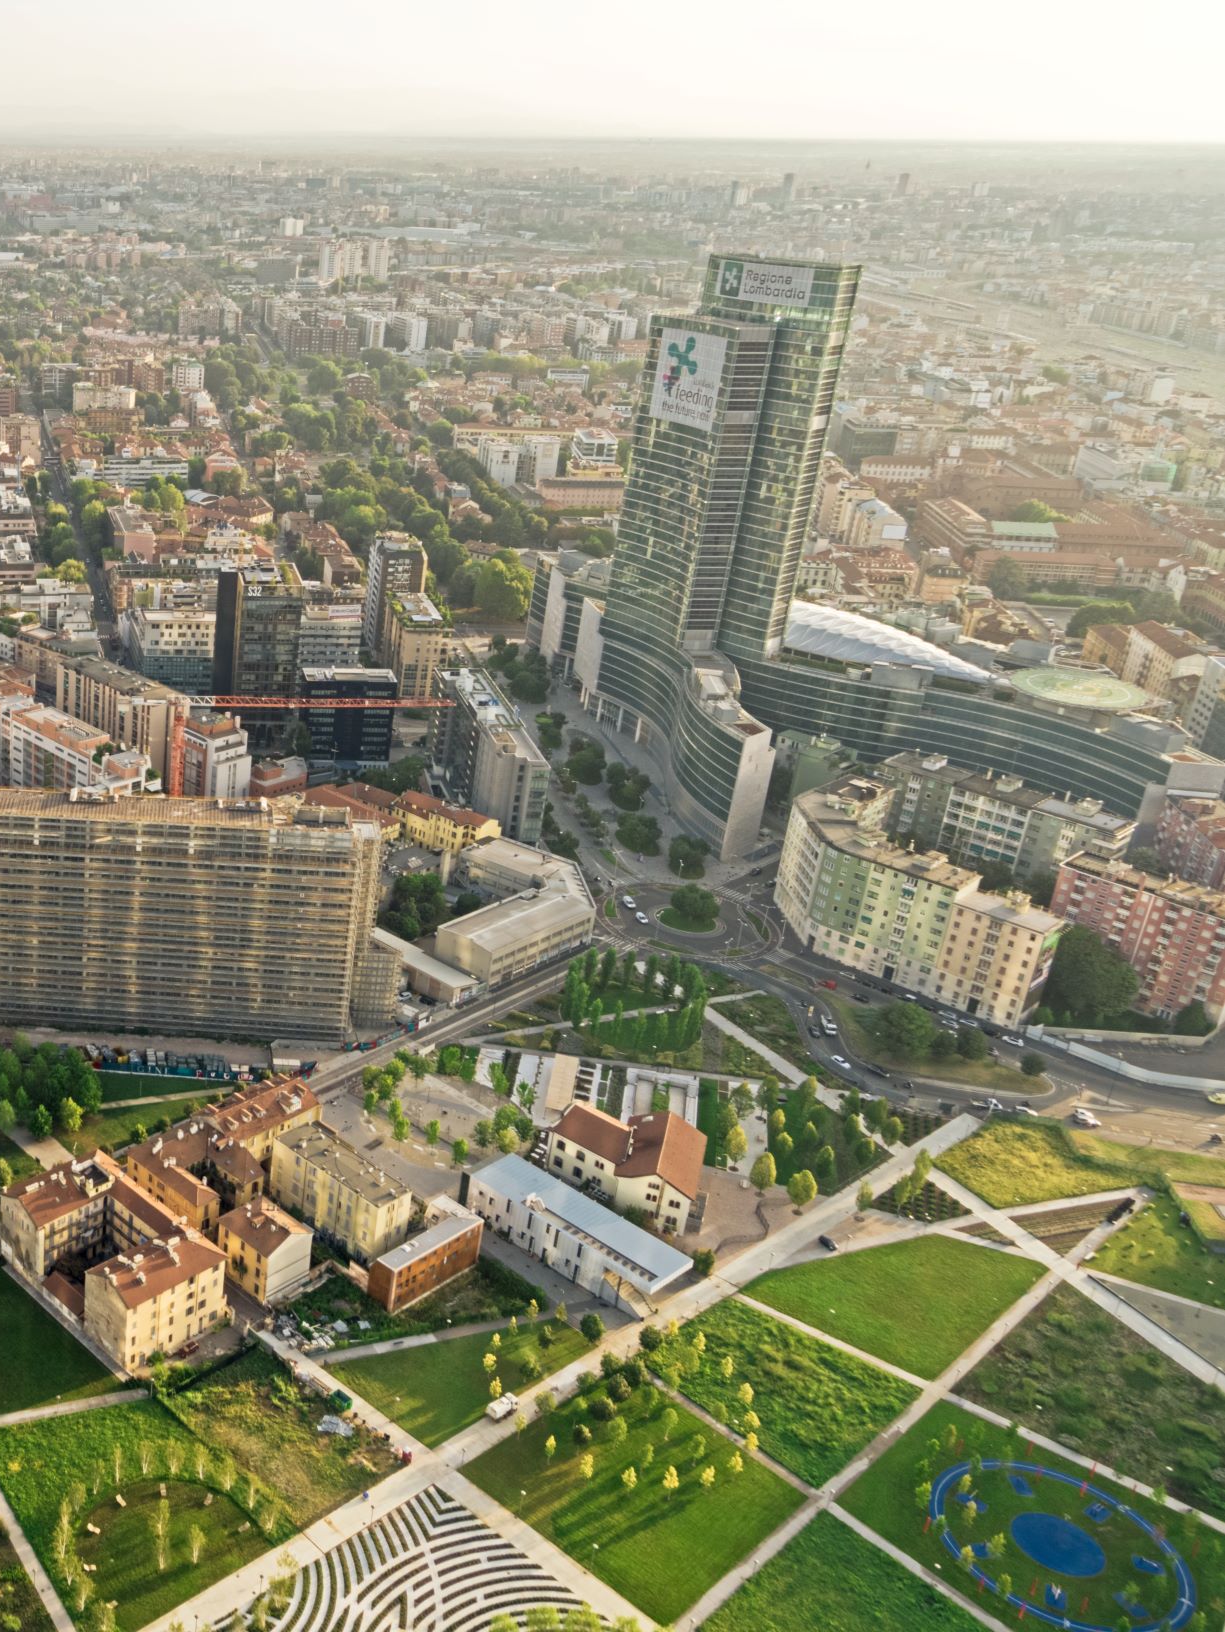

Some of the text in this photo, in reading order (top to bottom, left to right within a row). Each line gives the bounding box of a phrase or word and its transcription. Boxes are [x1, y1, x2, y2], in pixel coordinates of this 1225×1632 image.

[745, 269, 793, 285] Regione
[743, 282, 806, 300] Lombardia
[662, 400, 674, 413] the
[675, 384, 714, 413] feeding
[247, 586, 262, 597] S32
